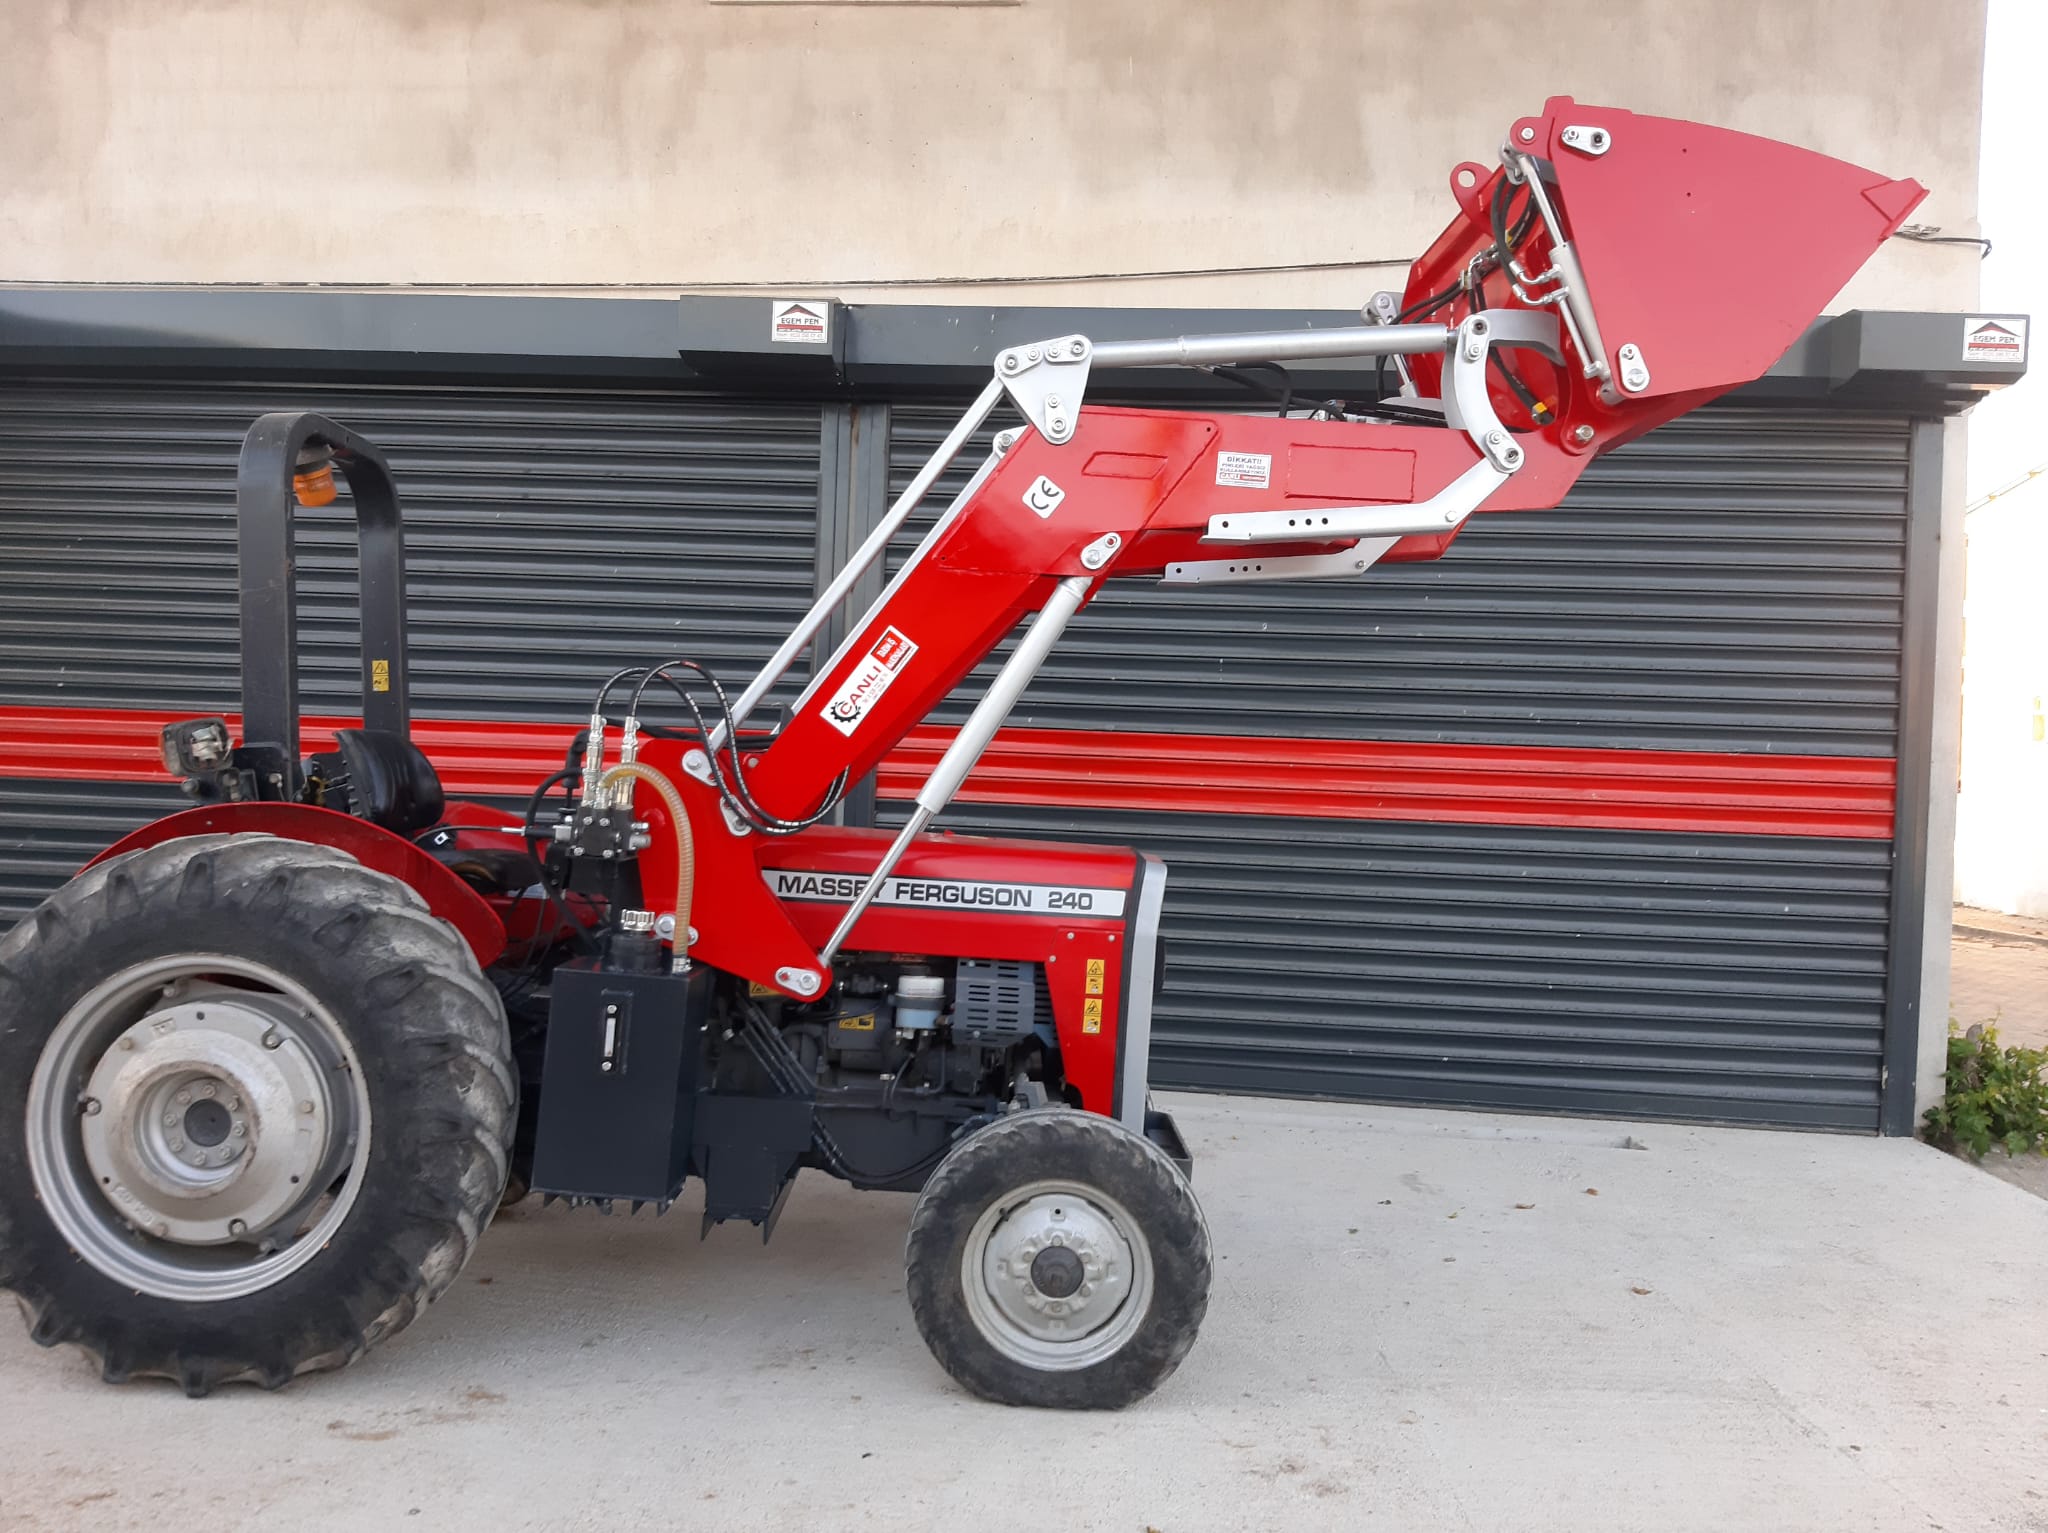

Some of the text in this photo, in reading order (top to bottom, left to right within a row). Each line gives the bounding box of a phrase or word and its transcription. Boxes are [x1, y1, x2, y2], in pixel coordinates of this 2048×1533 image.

[840, 665, 882, 715] CANLI
[896, 882, 1032, 907] FERGUSON
[1047, 891, 1093, 910] 240
